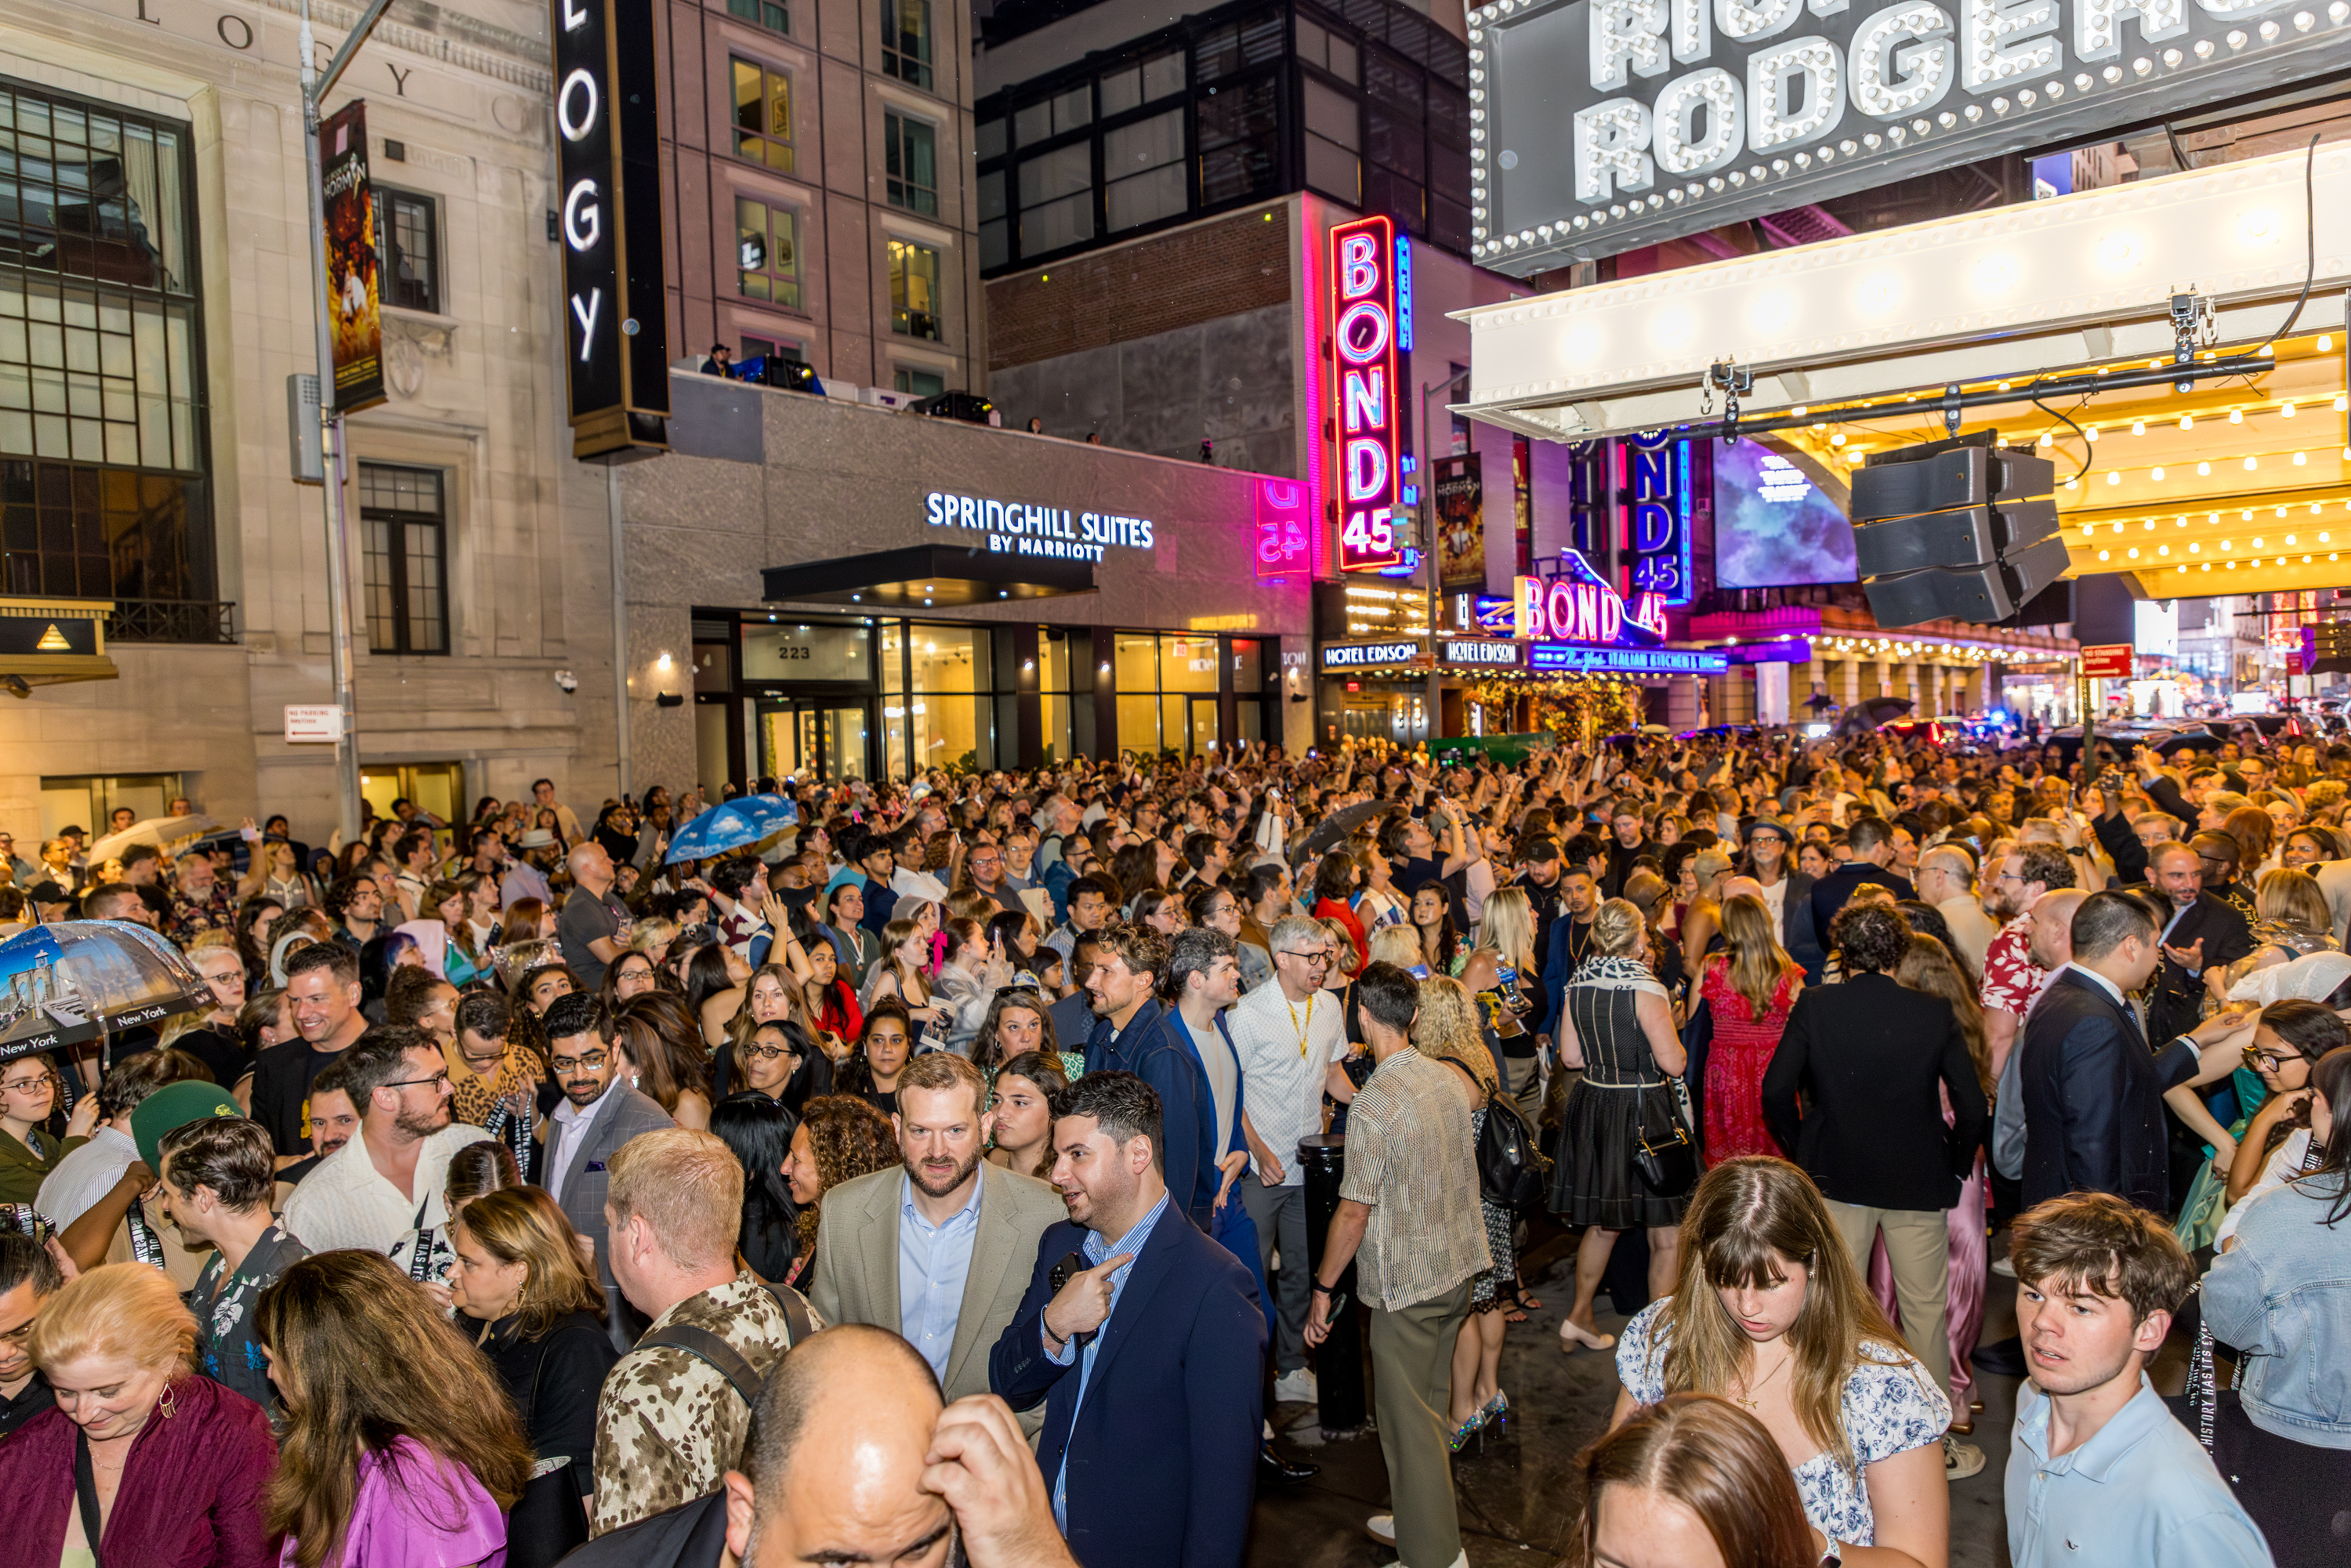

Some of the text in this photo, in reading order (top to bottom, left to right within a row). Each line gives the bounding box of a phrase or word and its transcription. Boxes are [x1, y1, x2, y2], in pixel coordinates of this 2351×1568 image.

[1574, 0, 2277, 204] RODGE
[1337, 233, 1389, 504] BOND
[927, 492, 1154, 549] SPRINGHILL SUITES
[1342, 507, 1393, 554] 45
[989, 534, 1104, 563] BY MARRIOTT
[1633, 556, 1679, 591] 45
[1523, 575, 1621, 643] BOND
[1638, 591, 1668, 641] 45
[779, 646, 810, 659] 223
[1325, 647, 1365, 664] HOTEL
[1367, 643, 1417, 663] EDISON
[1448, 641, 1480, 663] HOTEL
[1480, 643, 1516, 664] EDISON
[1609, 652, 1647, 667] ITALIAN
[1650, 654, 1689, 668] KITCHEN
[2094, 647, 2125, 657] STANDING
[118, 1006, 167, 1027] New York
[1, 1034, 58, 1056] New York
[415, 1244, 430, 1262] HAS
[411, 1266, 425, 1282] ITS
[2201, 1349, 2215, 1369] ITS
[2201, 1373, 2215, 1396] HAS
[2200, 1399, 2215, 1446] HISTORY
